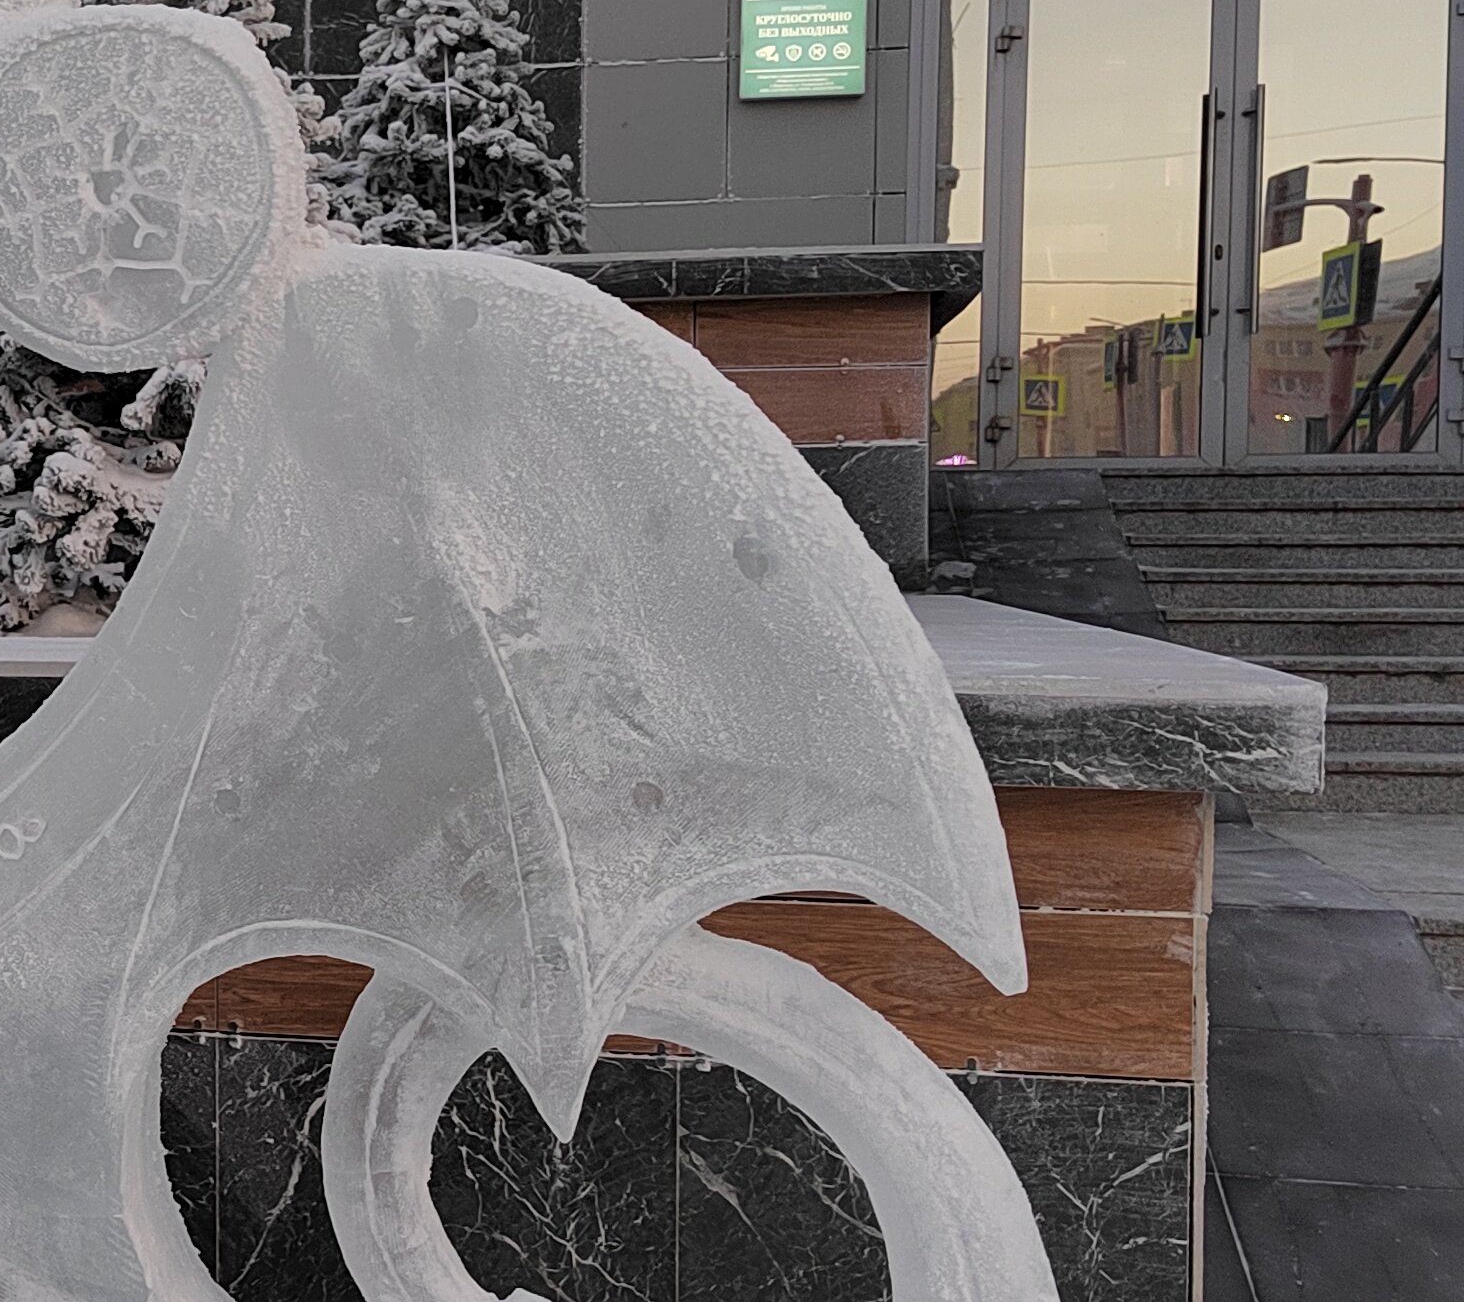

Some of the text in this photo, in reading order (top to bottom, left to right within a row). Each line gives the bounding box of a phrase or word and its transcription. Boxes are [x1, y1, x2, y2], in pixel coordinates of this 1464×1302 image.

[755, 11, 853, 26] КРУГЛОСУТОЧНО
[758, 24, 849, 38] БЕЗ ВЫХОДНЫХ
